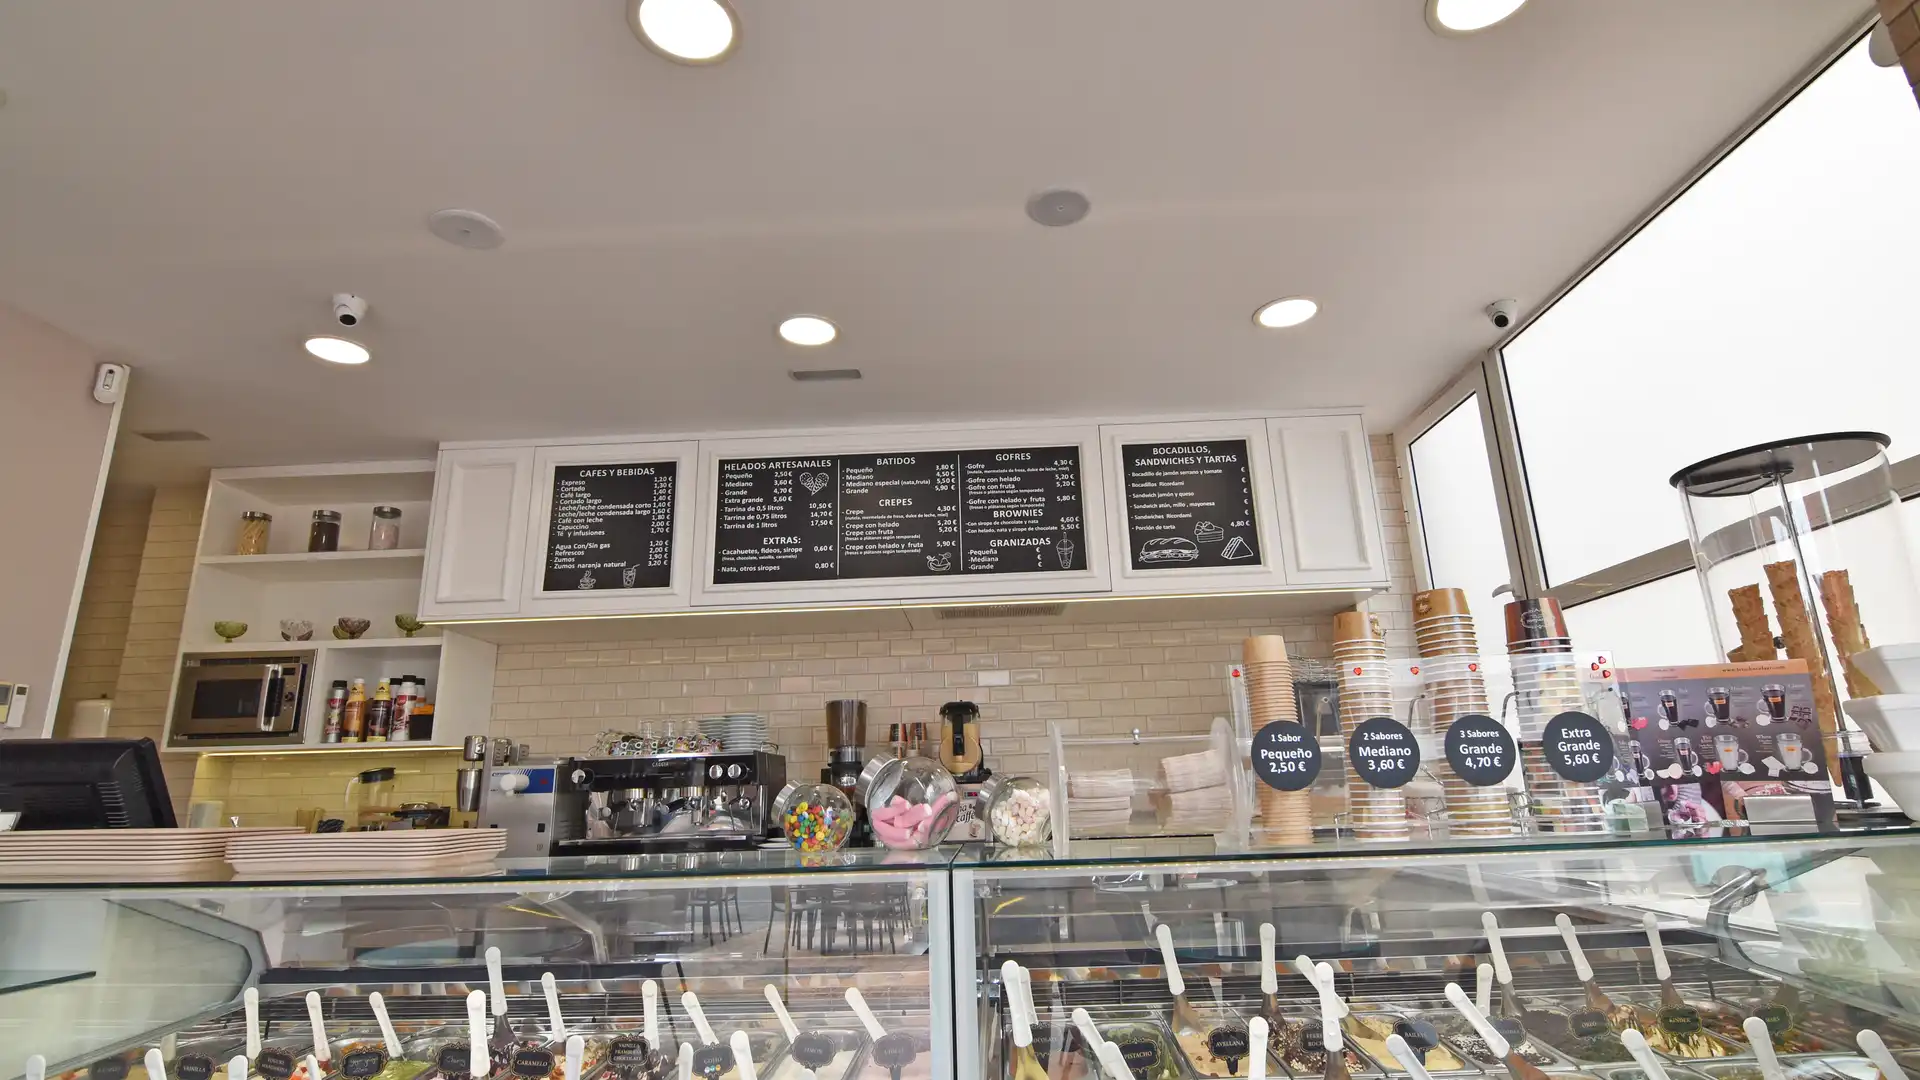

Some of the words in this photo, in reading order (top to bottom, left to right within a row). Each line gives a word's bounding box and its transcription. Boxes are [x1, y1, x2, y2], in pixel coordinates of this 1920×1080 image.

[1153, 446, 1211, 454] BOCADILLOS,
[877, 457, 915, 465] BATIDOS
[996, 453, 1031, 461] GOFRES
[1135, 457, 1194, 466] SANDWICHES
[1204, 455, 1237, 463] TARTAS
[769, 460, 831, 469] ARTESANALES
[617, 468, 655, 476] BEBIDAS
[993, 509, 1043, 518] BROWNIES
[763, 536, 801, 544] EXTRAS:
[990, 538, 1051, 547] GRANIZADAS
[1271, 734, 1275, 742] 1
[1277, 733, 1301, 742] Sabor
[1371, 732, 1402, 741] Sabores
[1467, 730, 1499, 739] Sabores
[1562, 728, 1591, 739] Extra
[1359, 746, 1411, 757] Mediano
[1460, 744, 1502, 755] Grande
[1558, 741, 1600, 753] Grande
[1260, 749, 1312, 761] Pequeño
[1564, 754, 1589, 766] 5,60
[1592, 753, 1600, 764] €
[1368, 759, 1393, 770] 3,60
[1396, 759, 1405, 769] €
[1465, 757, 1490, 768] 4,70
[1493, 756, 1501, 767] €
[1270, 762, 1296, 773] 2,50
[1298, 761, 1306, 772] €
[1124, 1051, 1153, 1060] PISTACHO
[516, 1059, 548, 1067] CARAMELO
[182, 1065, 207, 1073] VAINILLA
